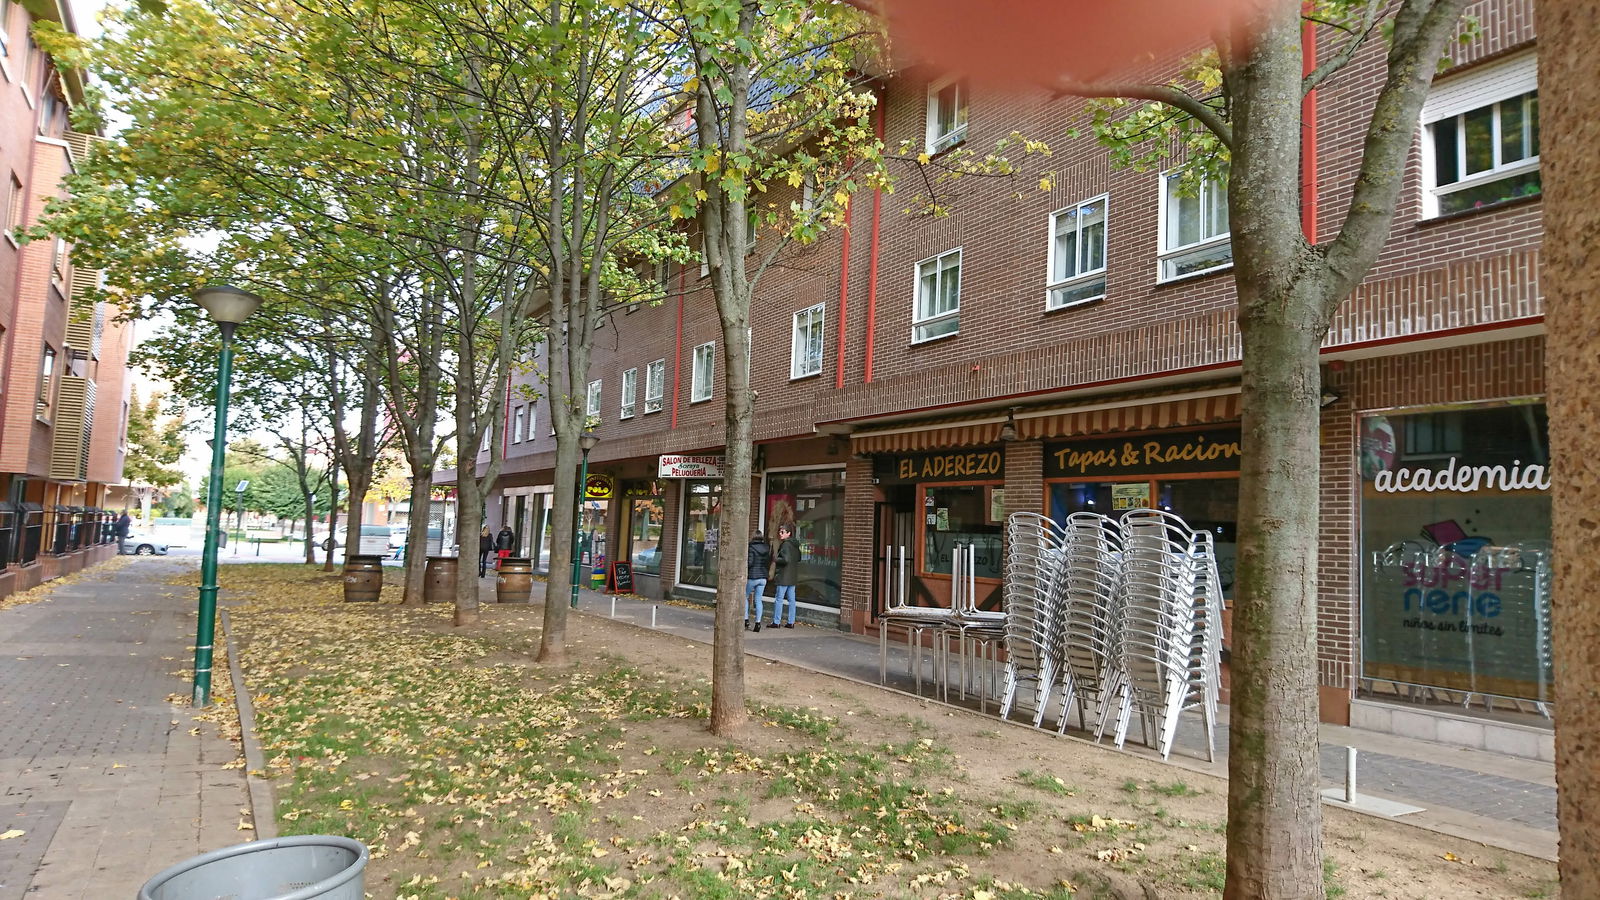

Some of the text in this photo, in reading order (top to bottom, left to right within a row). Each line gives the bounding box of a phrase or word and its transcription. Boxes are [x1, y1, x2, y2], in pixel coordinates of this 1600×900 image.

[662, 457, 681, 467] SALON
[692, 456, 717, 466] BELLEZA
[899, 451, 1001, 479] EL ADEREZO
[1054, 435, 1241, 474] Tapas & Racion
[1374, 456, 1551, 493] academia
[587, 486, 609, 494] POLO
[1403, 588, 1503, 618] nene
[1437, 621, 1457, 632] sin
